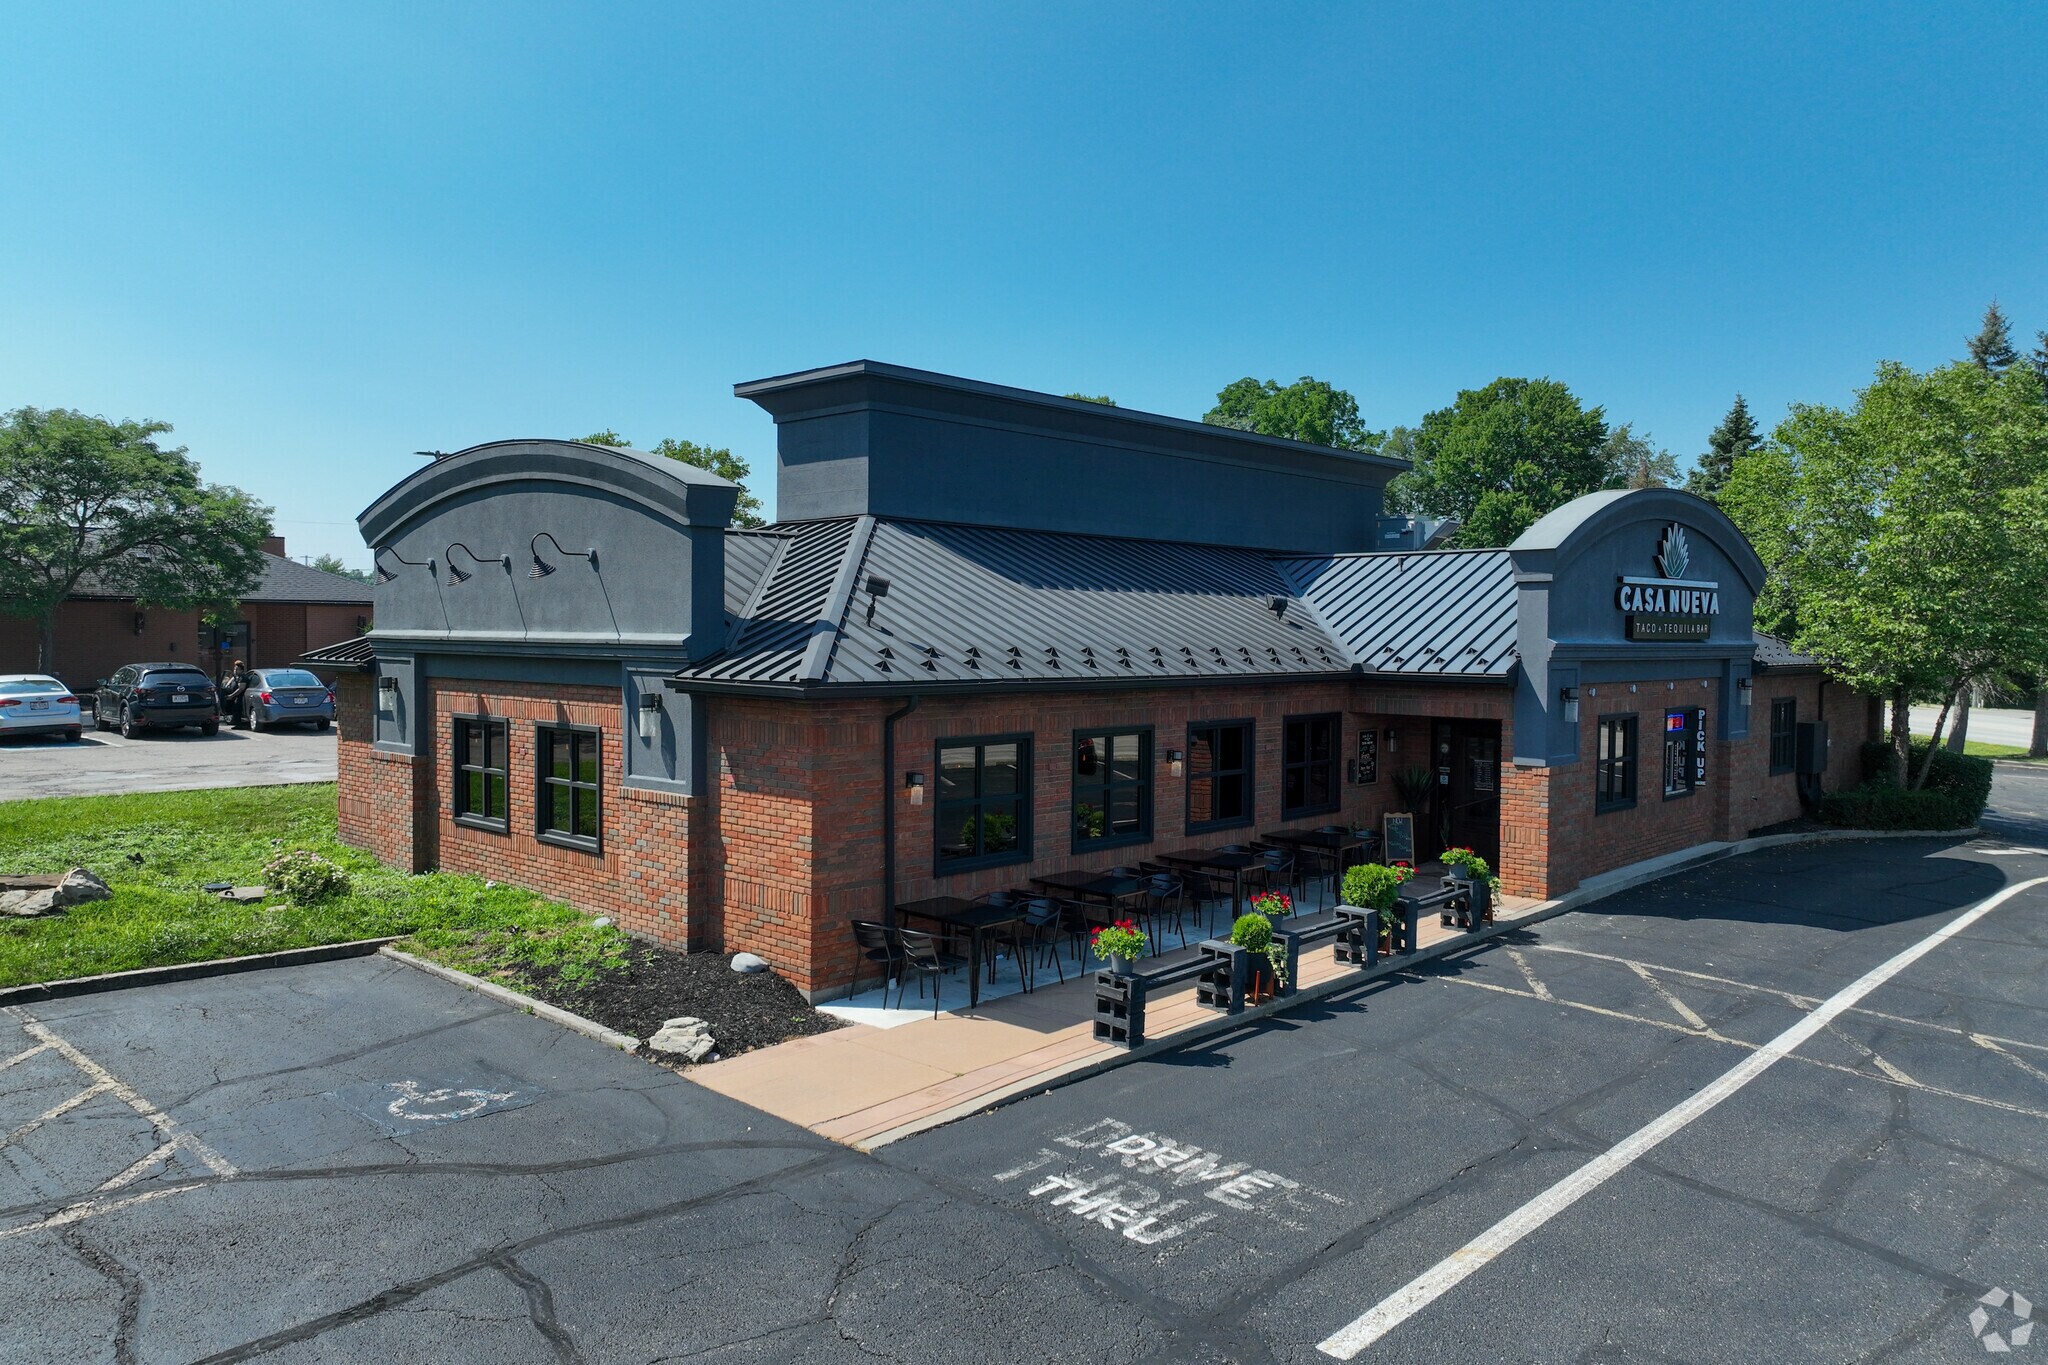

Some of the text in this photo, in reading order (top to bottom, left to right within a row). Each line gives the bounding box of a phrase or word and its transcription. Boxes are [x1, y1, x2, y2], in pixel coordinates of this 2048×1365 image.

[1620, 585, 1720, 615] CASA NUEVA
[1635, 622, 1656, 633] TACO
[1664, 623, 1695, 634] TEQUILA
[1696, 624, 1709, 634] BAR
[1696, 709, 1706, 779] PICK UP
[1106, 1134, 1280, 1200] DRIVE
[1028, 1174, 1190, 1245] THRU
